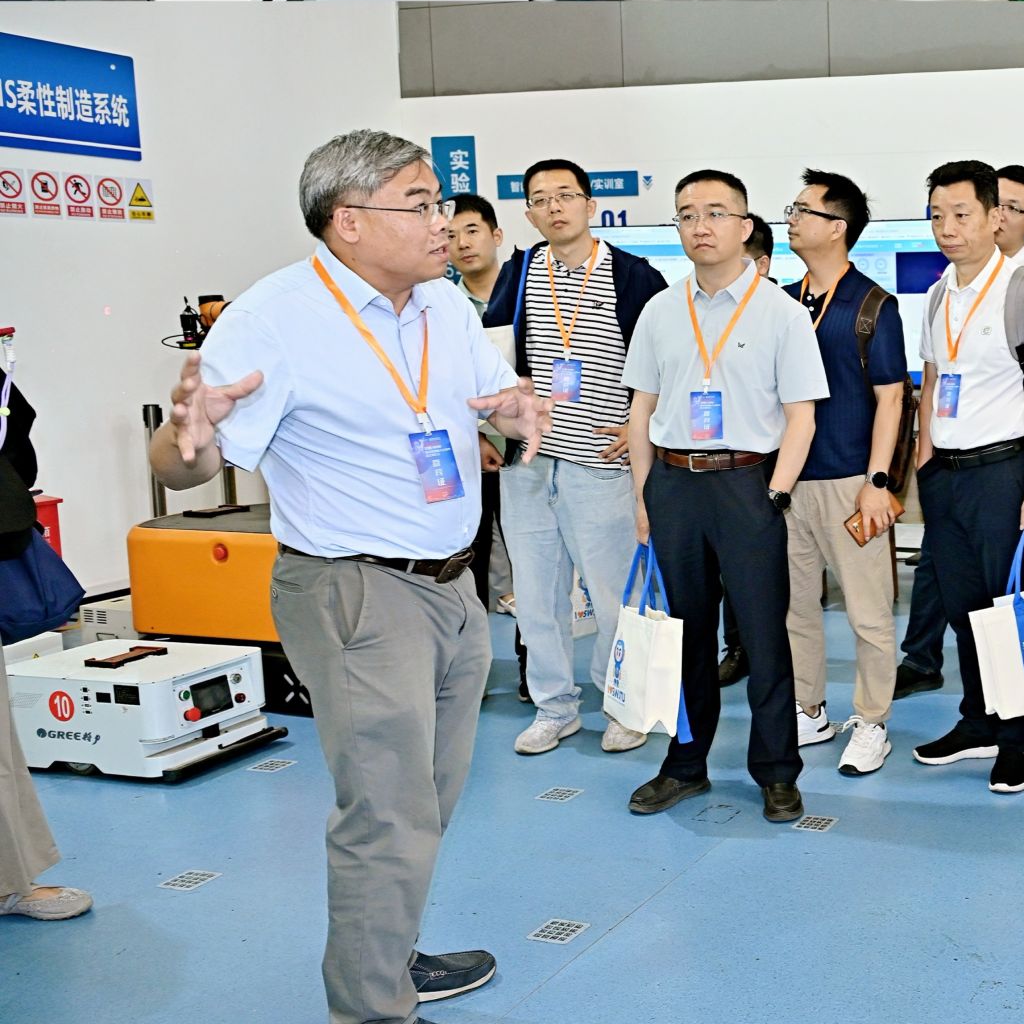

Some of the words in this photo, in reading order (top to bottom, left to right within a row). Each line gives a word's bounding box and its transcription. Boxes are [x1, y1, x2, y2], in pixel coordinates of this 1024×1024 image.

[0, 79, 130, 128] S柔性制造系统
[450, 150, 471, 193] 实验
[601, 210, 628, 227] 01
[612, 687, 626, 702] SWJTU
[53, 695, 70, 719] 10
